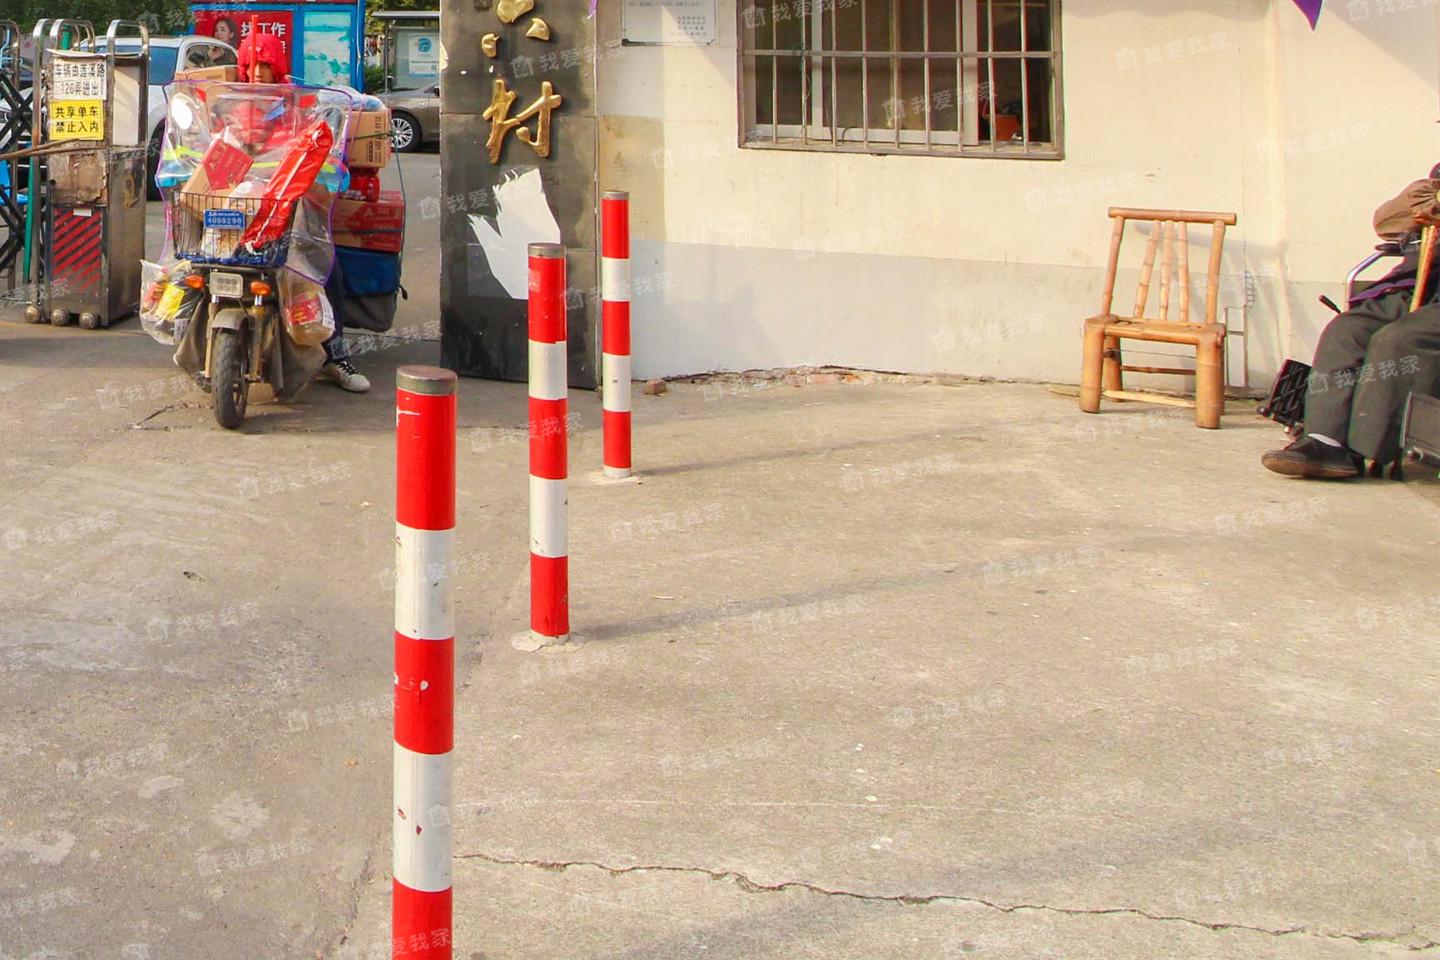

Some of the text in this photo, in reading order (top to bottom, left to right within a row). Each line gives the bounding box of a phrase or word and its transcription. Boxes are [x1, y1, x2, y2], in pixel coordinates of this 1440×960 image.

[56, 105, 98, 118] 共享单车
[56, 121, 99, 133] 禁止入内
